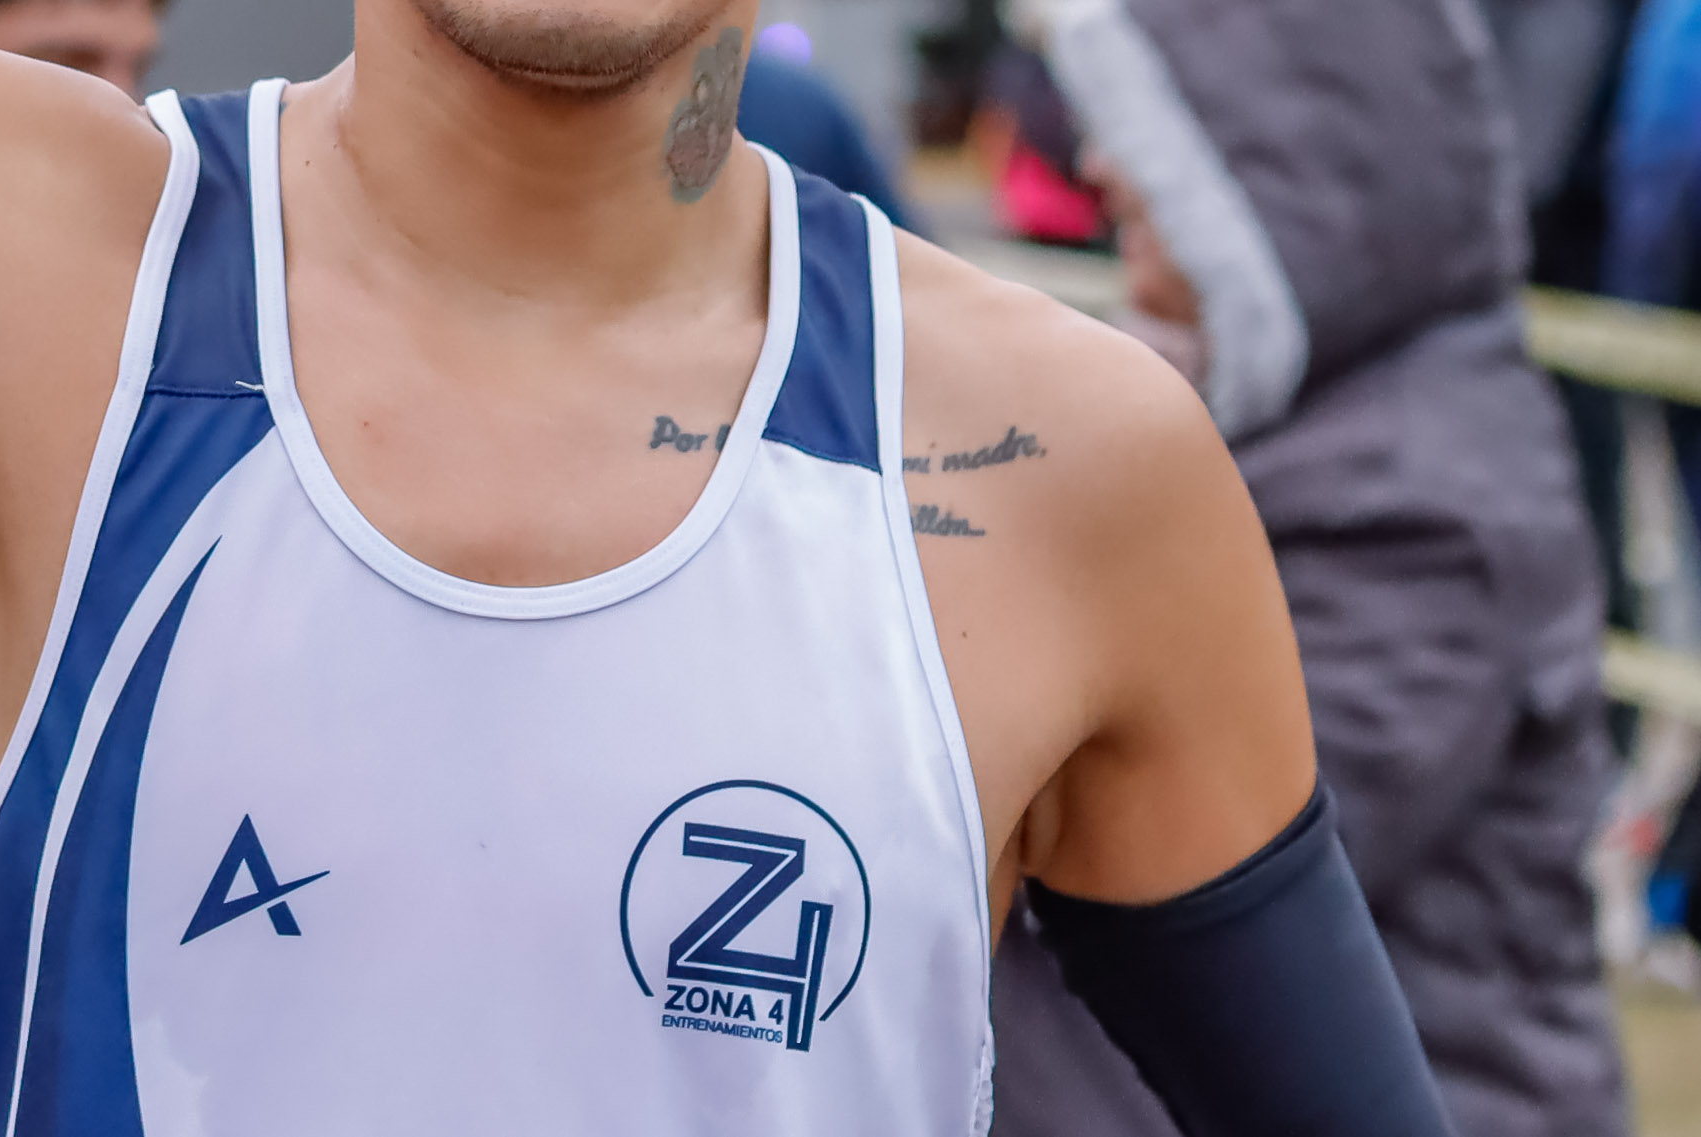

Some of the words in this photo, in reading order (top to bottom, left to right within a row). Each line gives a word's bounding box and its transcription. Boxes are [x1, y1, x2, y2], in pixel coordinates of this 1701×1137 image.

[650, 415, 708, 453] Por
[664, 984, 756, 1021] ZONA
[768, 998, 784, 1025] 4
[661, 1014, 783, 1043] ENTRENAMIENTOS
